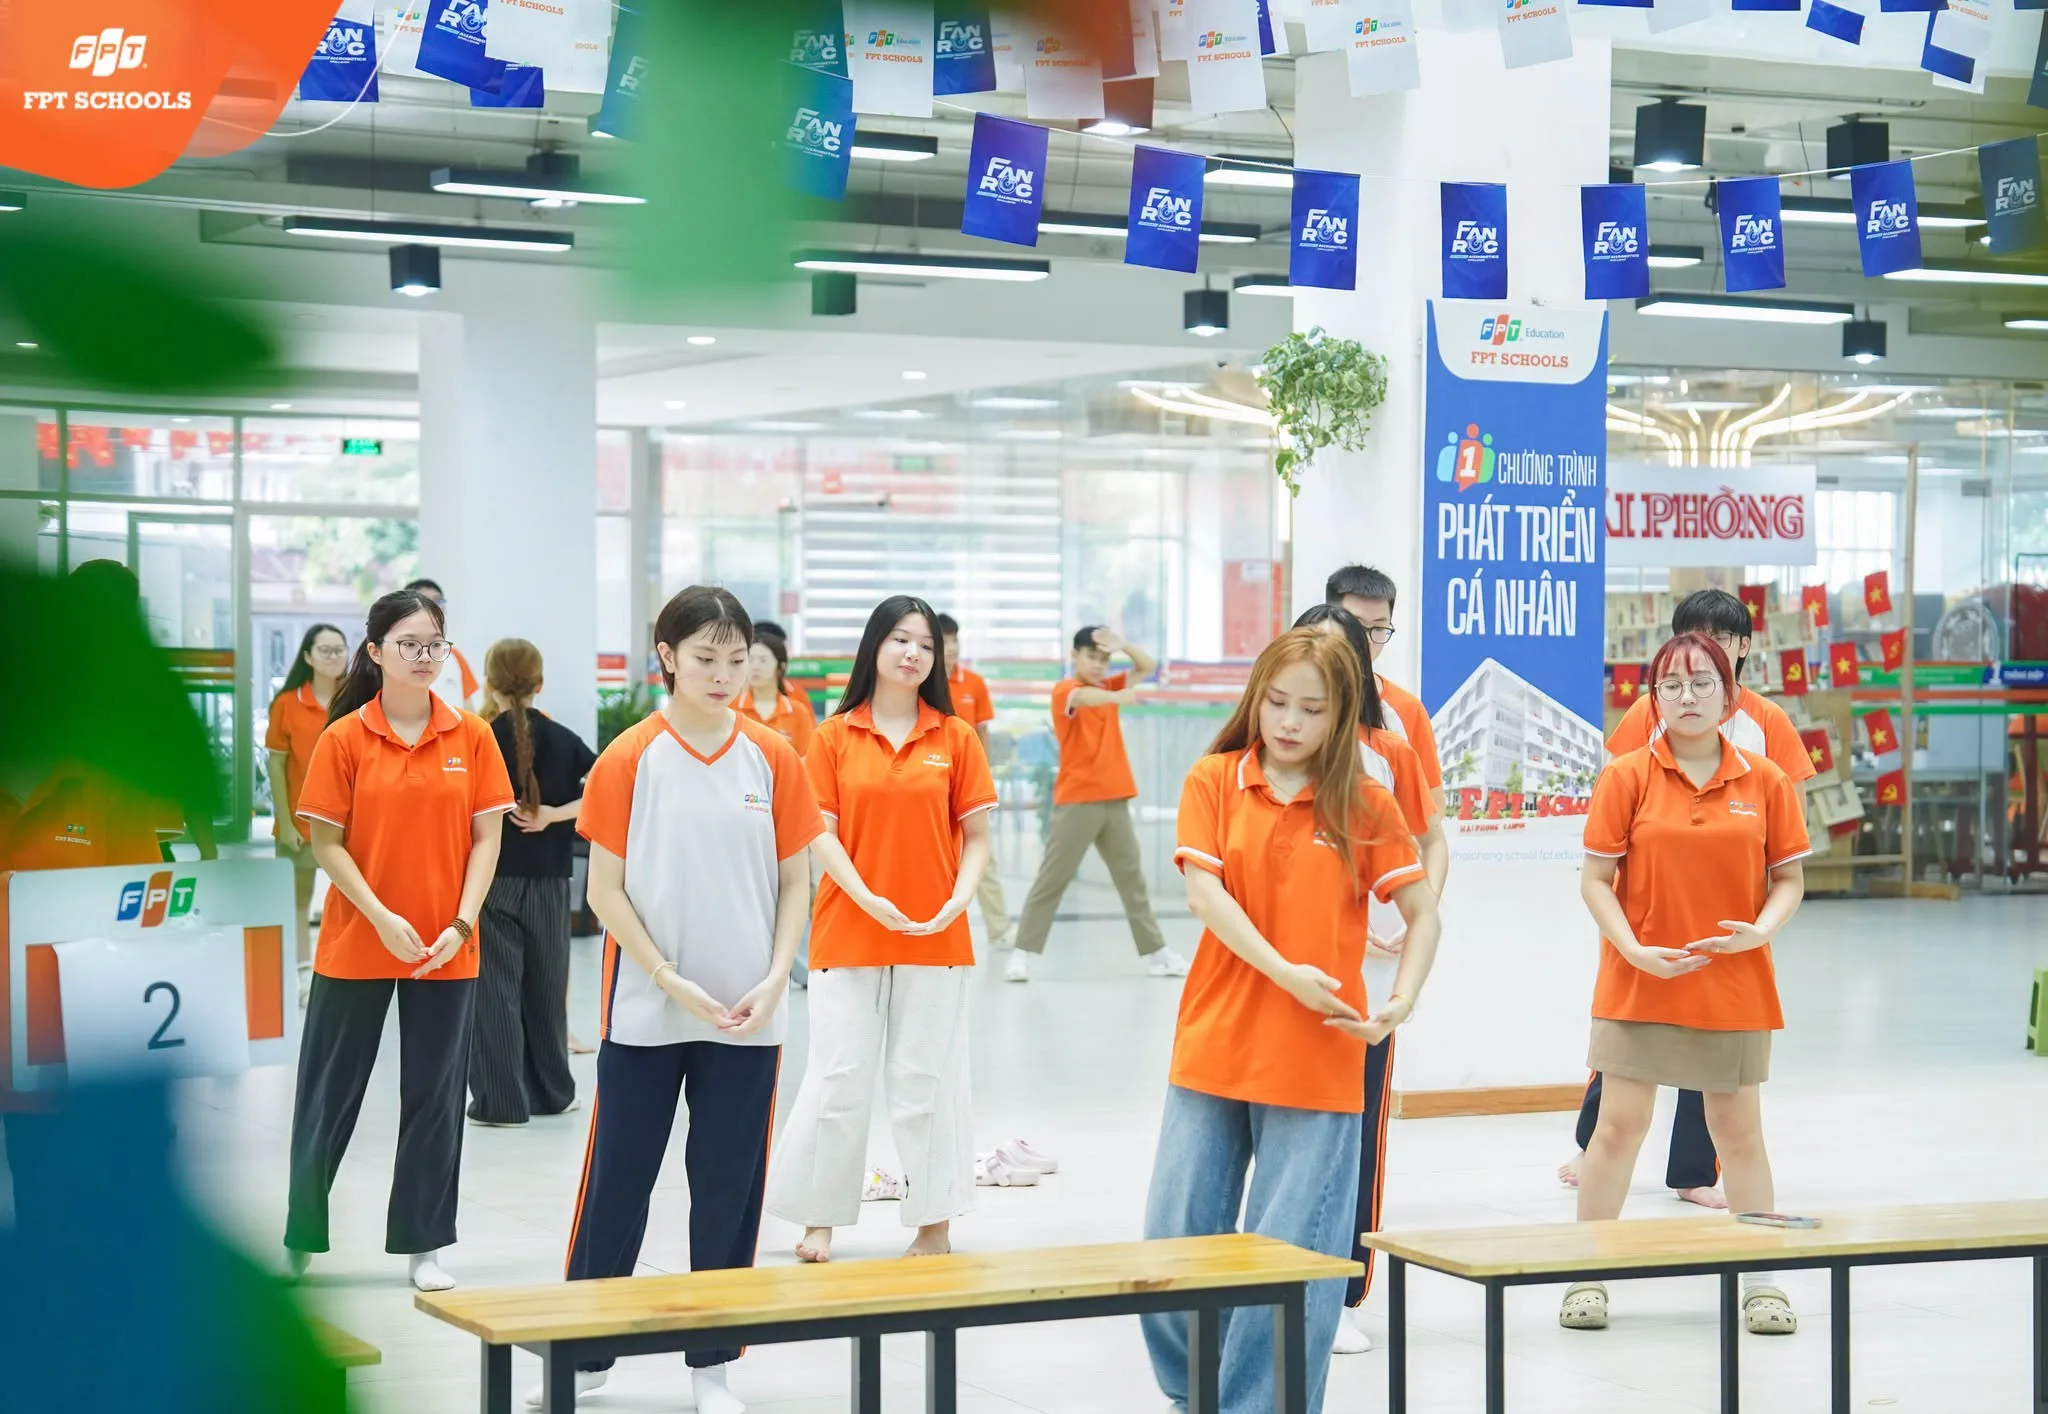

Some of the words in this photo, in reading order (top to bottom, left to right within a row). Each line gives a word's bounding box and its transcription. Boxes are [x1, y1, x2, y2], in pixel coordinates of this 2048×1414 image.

[519, 0, 565, 15] SCHOOLS
[1507, 14, 1521, 23] FPT
[1522, 7, 1557, 20] SCHOOLS
[940, 21, 981, 41] FAN
[1355, 17, 1378, 35] FPT
[793, 29, 834, 49] FAN
[868, 30, 895, 47] FPT
[1199, 31, 1223, 48] FPT
[1371, 36, 1406, 47] SCHOOLS
[865, 52, 881, 60] FPT
[882, 54, 923, 63] SCHOOLS
[1214, 51, 1251, 61] SCHOOLS
[793, 107, 842, 137] FAN
[987, 156, 1034, 184] FAN
[1998, 177, 2033, 198] FAN
[1146, 187, 1192, 212] FAN
[1870, 200, 1906, 219] FAN
[1306, 208, 1348, 231] FAN
[1735, 214, 1772, 235] FAN
[1456, 220, 1497, 241] FAN
[1598, 221, 1637, 241] FAN
[1480, 314, 1522, 345] FPT
[1525, 328, 1564, 339] Education
[1471, 351, 1497, 364] FPT
[1500, 352, 1569, 368] SCHOOLS
[1459, 446, 1476, 477] 1
[1497, 448, 1554, 485] CHƯƠNG
[1558, 450, 1597, 487] TRÌNH
[1641, 485, 1804, 540] PHÒNG
[1437, 493, 1510, 562] PHÁT
[1515, 489, 1597, 563] TRIỂN
[1446, 568, 1486, 636] CÁ
[1495, 571, 1577, 637] NHÂN
[1458, 788, 1525, 820] FPT
[116, 871, 197, 928] FPT
[143, 981, 186, 1050] 2
